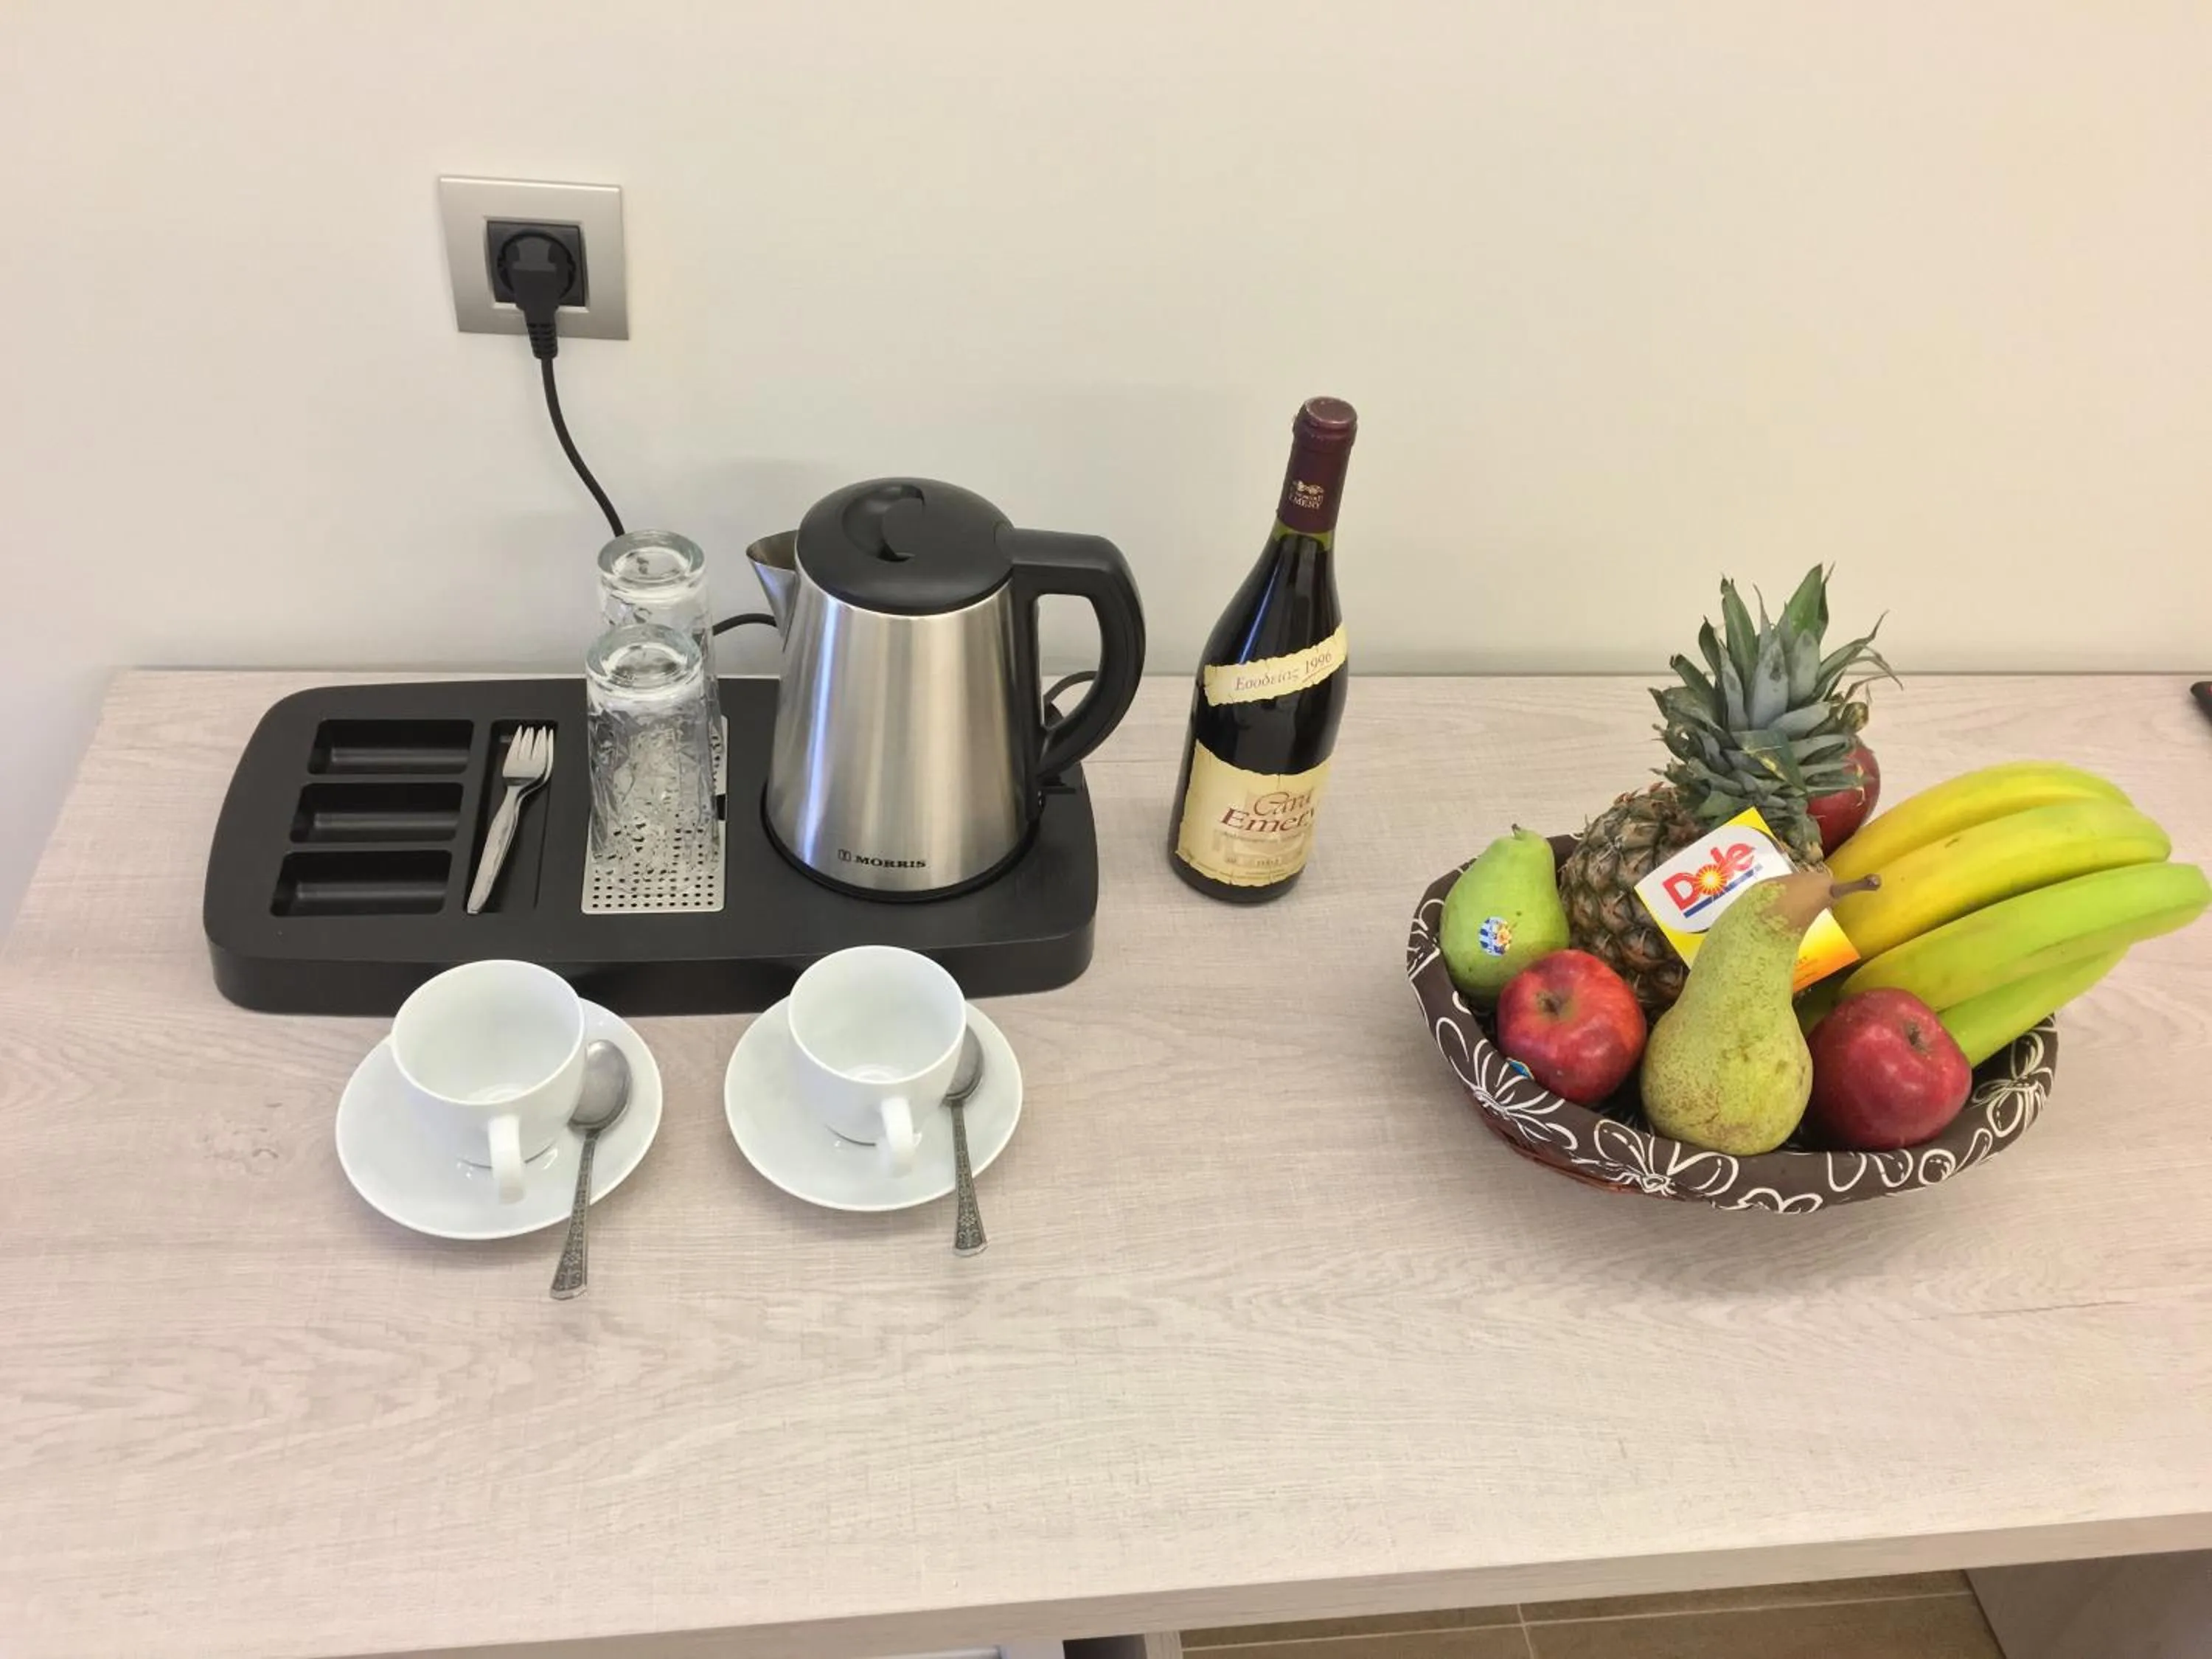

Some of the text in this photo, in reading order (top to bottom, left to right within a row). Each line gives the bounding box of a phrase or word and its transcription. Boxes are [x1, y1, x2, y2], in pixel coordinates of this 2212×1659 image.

[1304, 652, 1332, 675] 1996
[855, 855, 926, 868] MORRIS
[1662, 843, 1756, 911] Dole
